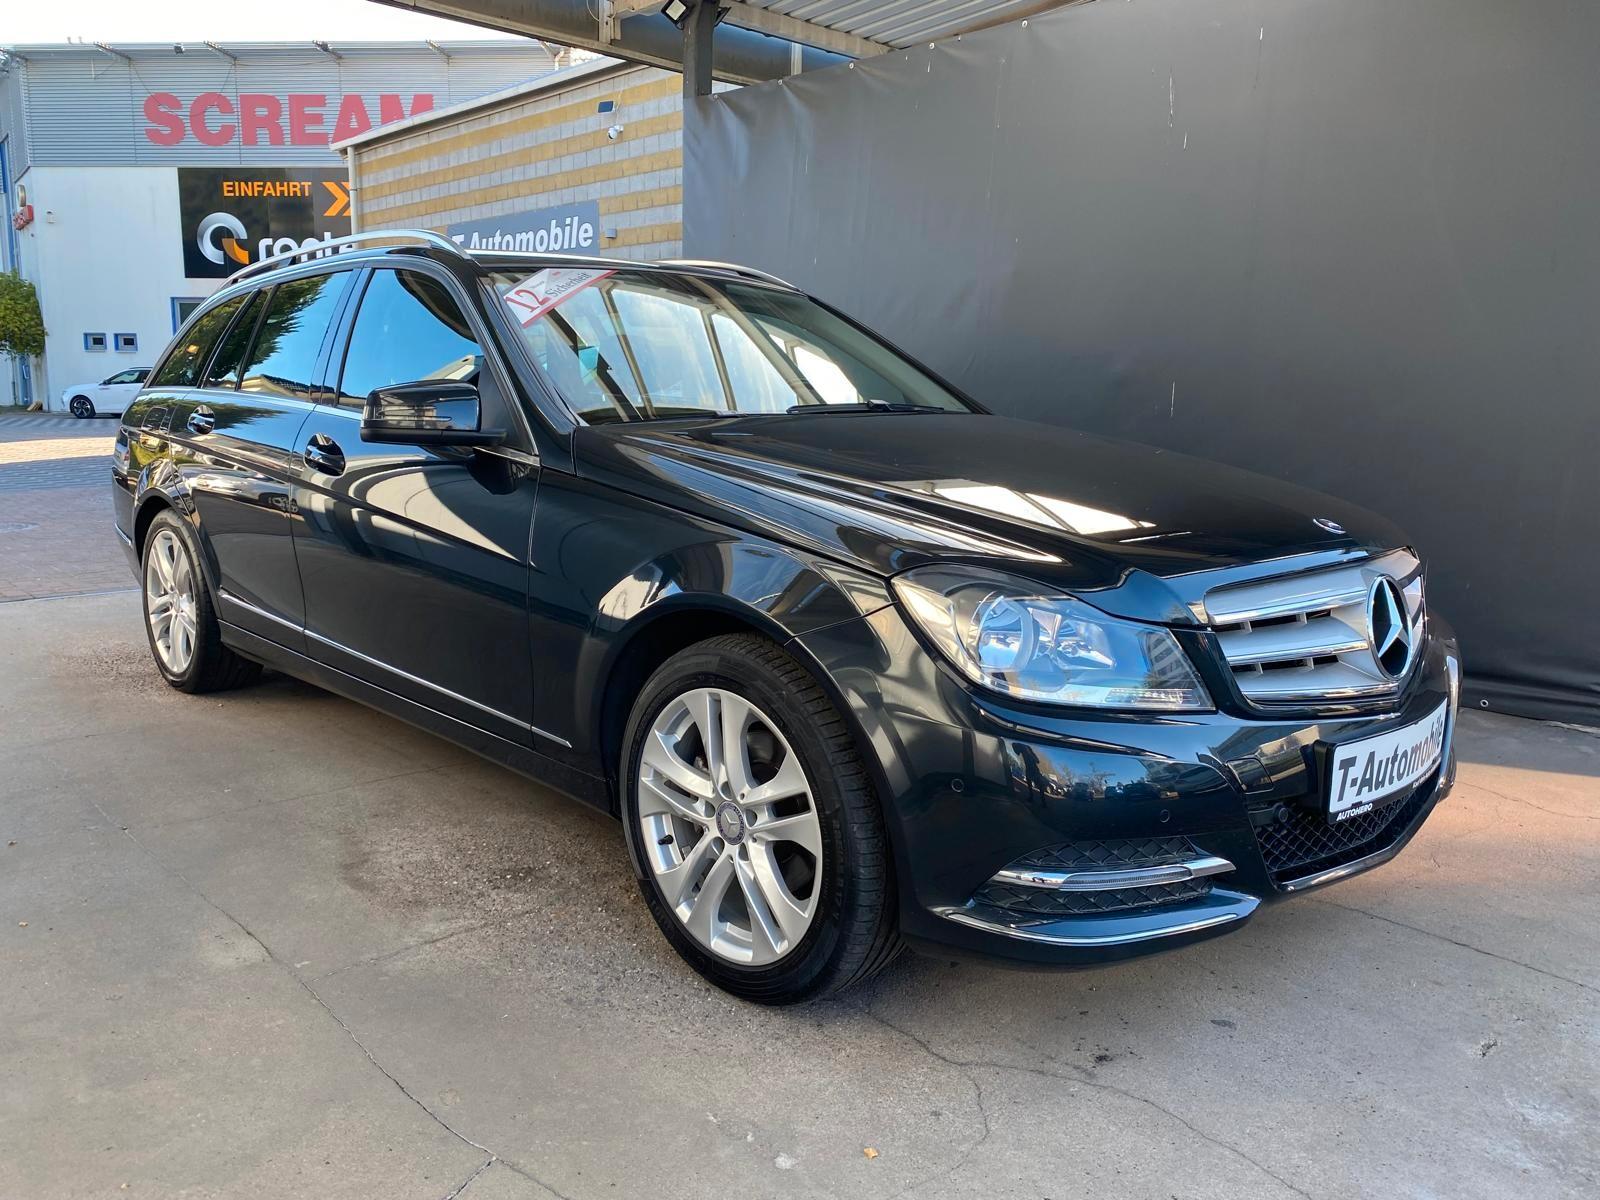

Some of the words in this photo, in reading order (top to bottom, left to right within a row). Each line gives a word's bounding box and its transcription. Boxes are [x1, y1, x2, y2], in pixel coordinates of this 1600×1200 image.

[222, 181, 312, 197] EINFAHRT
[451, 216, 594, 253] TAutomobile
[545, 272, 593, 298] Sicherheit
[505, 289, 552, 313] 12
[1336, 713, 1444, 803] T-Automobile
[1336, 802, 1373, 821] AUTOHERO
